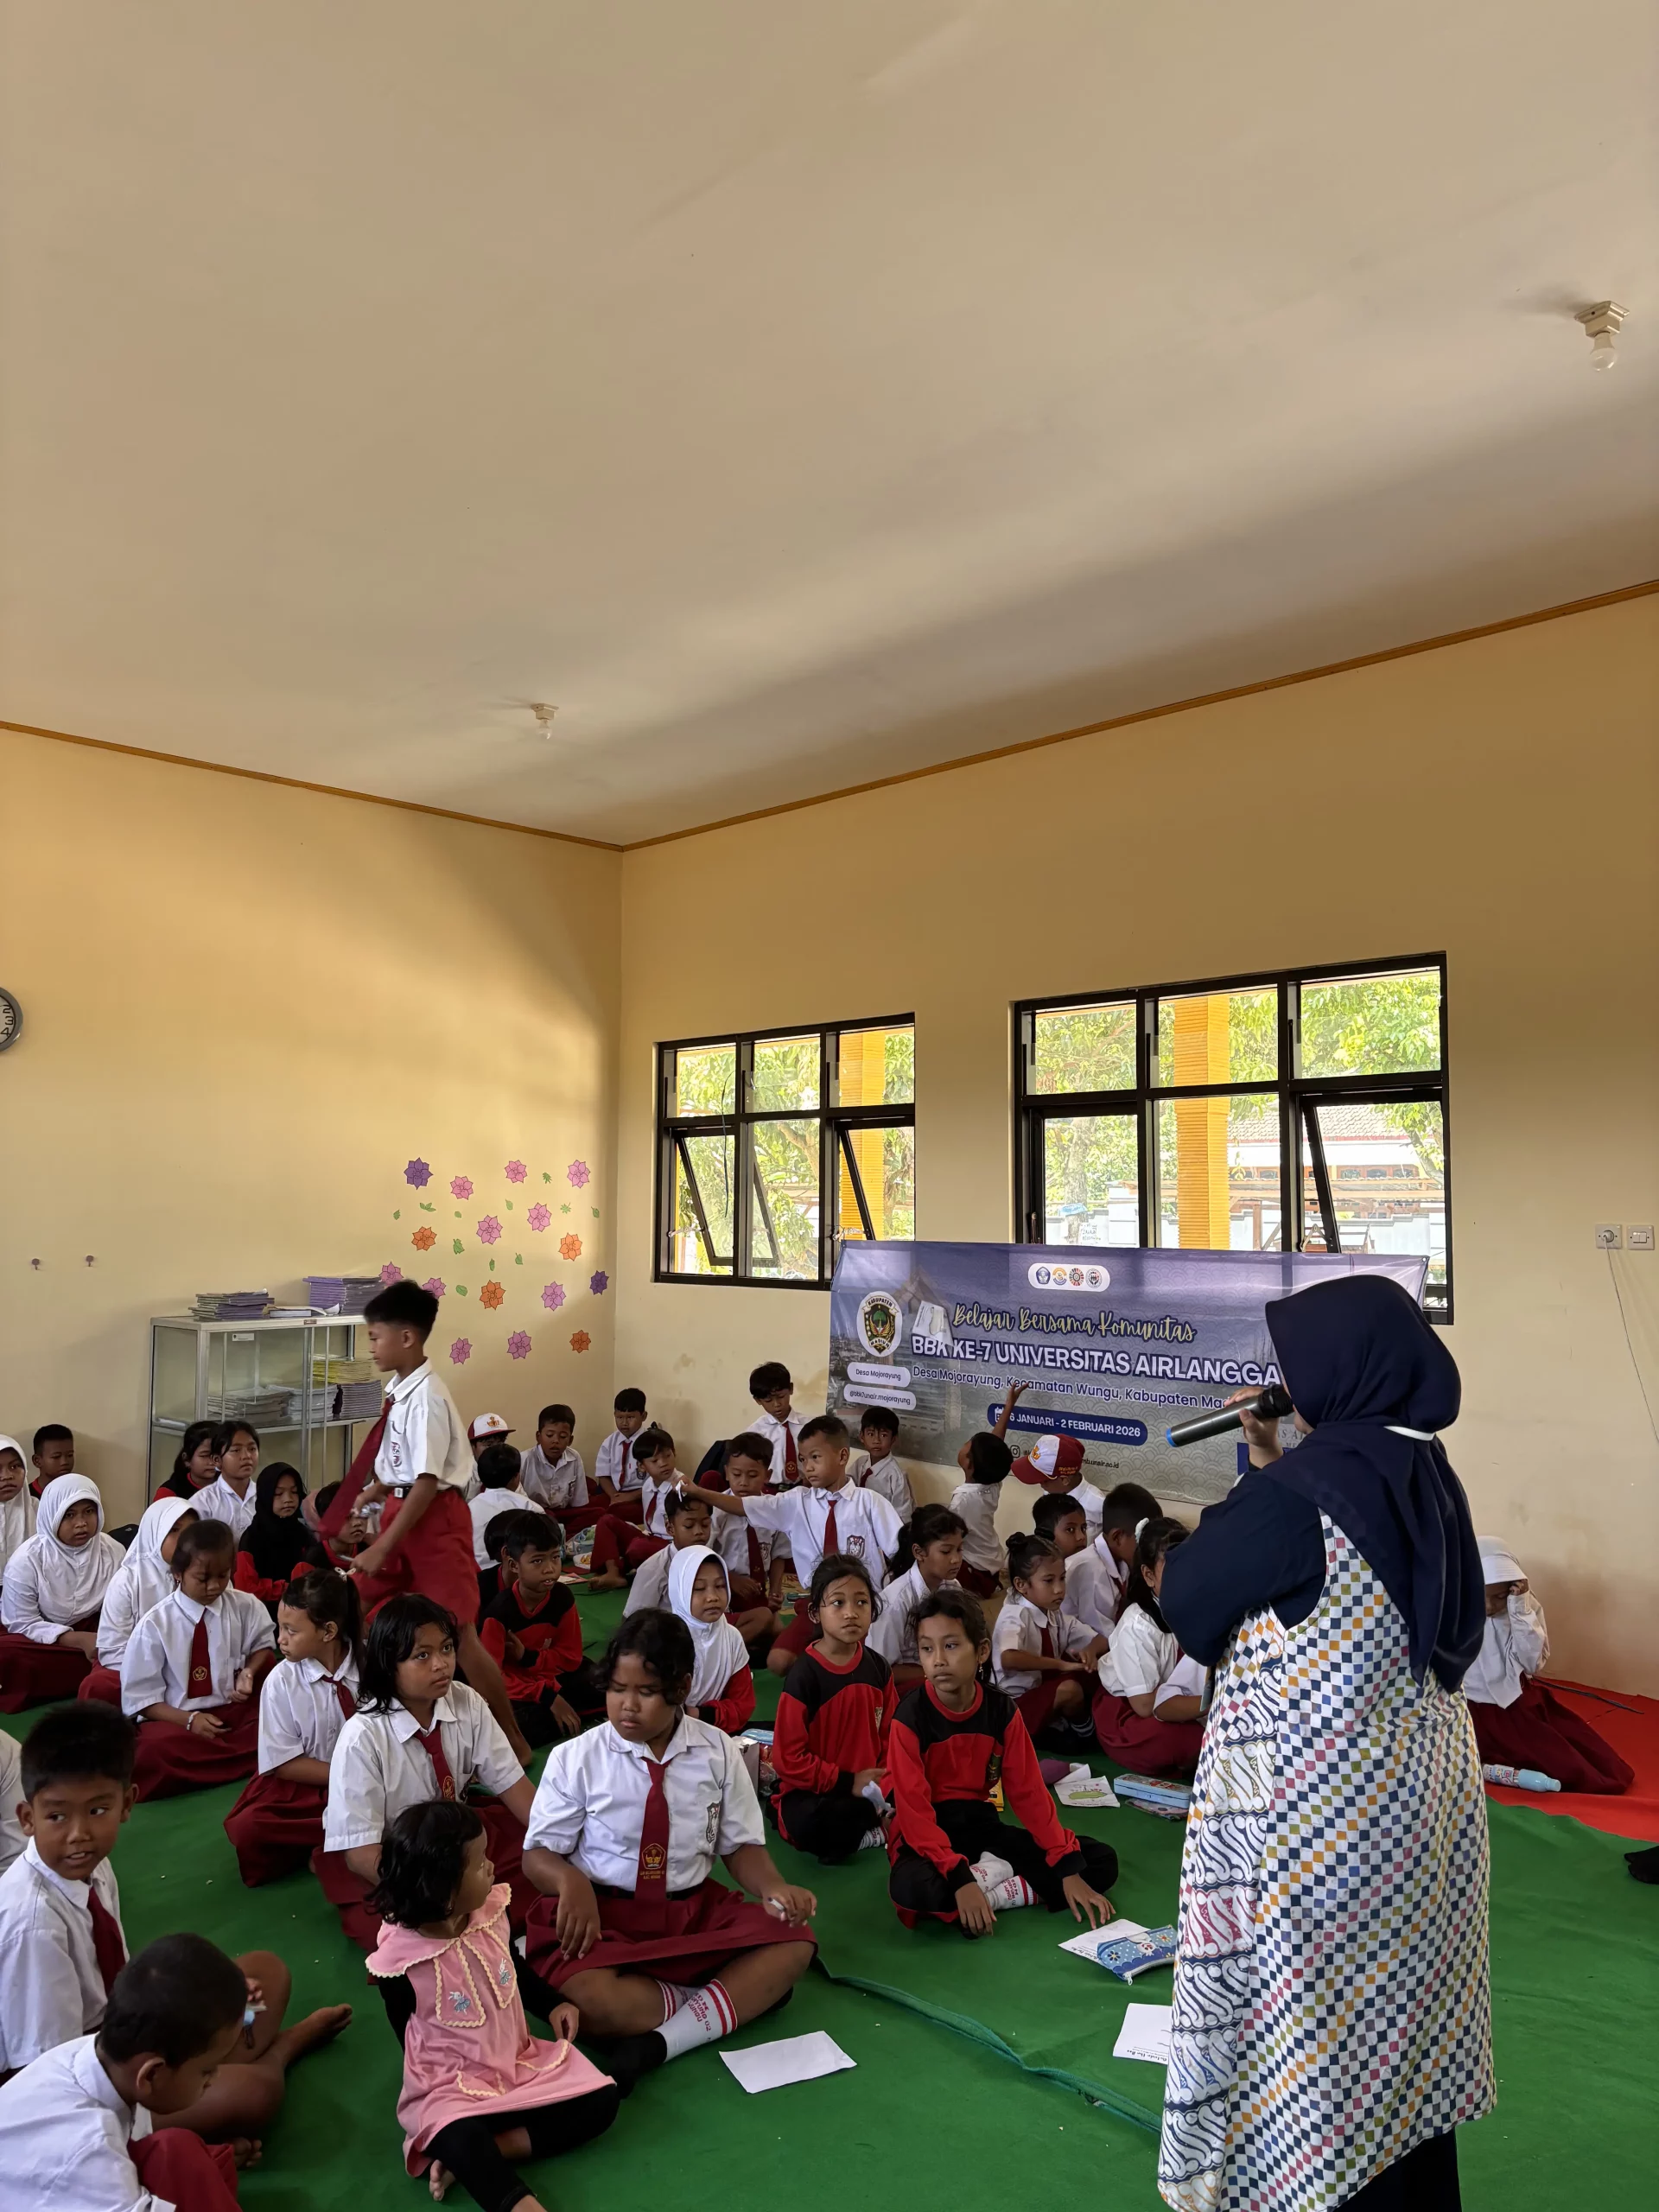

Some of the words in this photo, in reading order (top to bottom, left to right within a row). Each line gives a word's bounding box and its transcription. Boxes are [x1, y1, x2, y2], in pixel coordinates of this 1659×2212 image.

[3, 1004, 11, 1014] 2
[4, 1015, 14, 1026] 3
[0, 1027, 11, 1038] 4
[868, 1297, 893, 1308] KABUPATEN
[953, 1303, 1014, 1331] Belajar
[1020, 1308, 1096, 1336] Bersama
[1098, 1312, 1196, 1341] Komunitas
[870, 1338, 890, 1348] MADIUN
[912, 1336, 948, 1357] BBK
[952, 1339, 992, 1361] KE-7
[995, 1344, 1130, 1374] UNIVERSITAS
[1135, 1354, 1281, 1386] AIRLANGGA
[870, 1370, 901, 1382] Mojorayung
[913, 1366, 938, 1379] Desa
[939, 1369, 1004, 1389] Mojorayung,
[1007, 1376, 1073, 1394] Kecamatan
[1077, 1384, 1122, 1402] Wungu,
[1125, 1389, 1198, 1408] Kabupaten
[1201, 1395, 1230, 1409] Ma
[1016, 1414, 1055, 1427] JANUARI
[1060, 1419, 1067, 1428] 2
[1068, 1420, 1115, 1434] FEBRUARI
[1116, 1426, 1141, 1437] 2026
